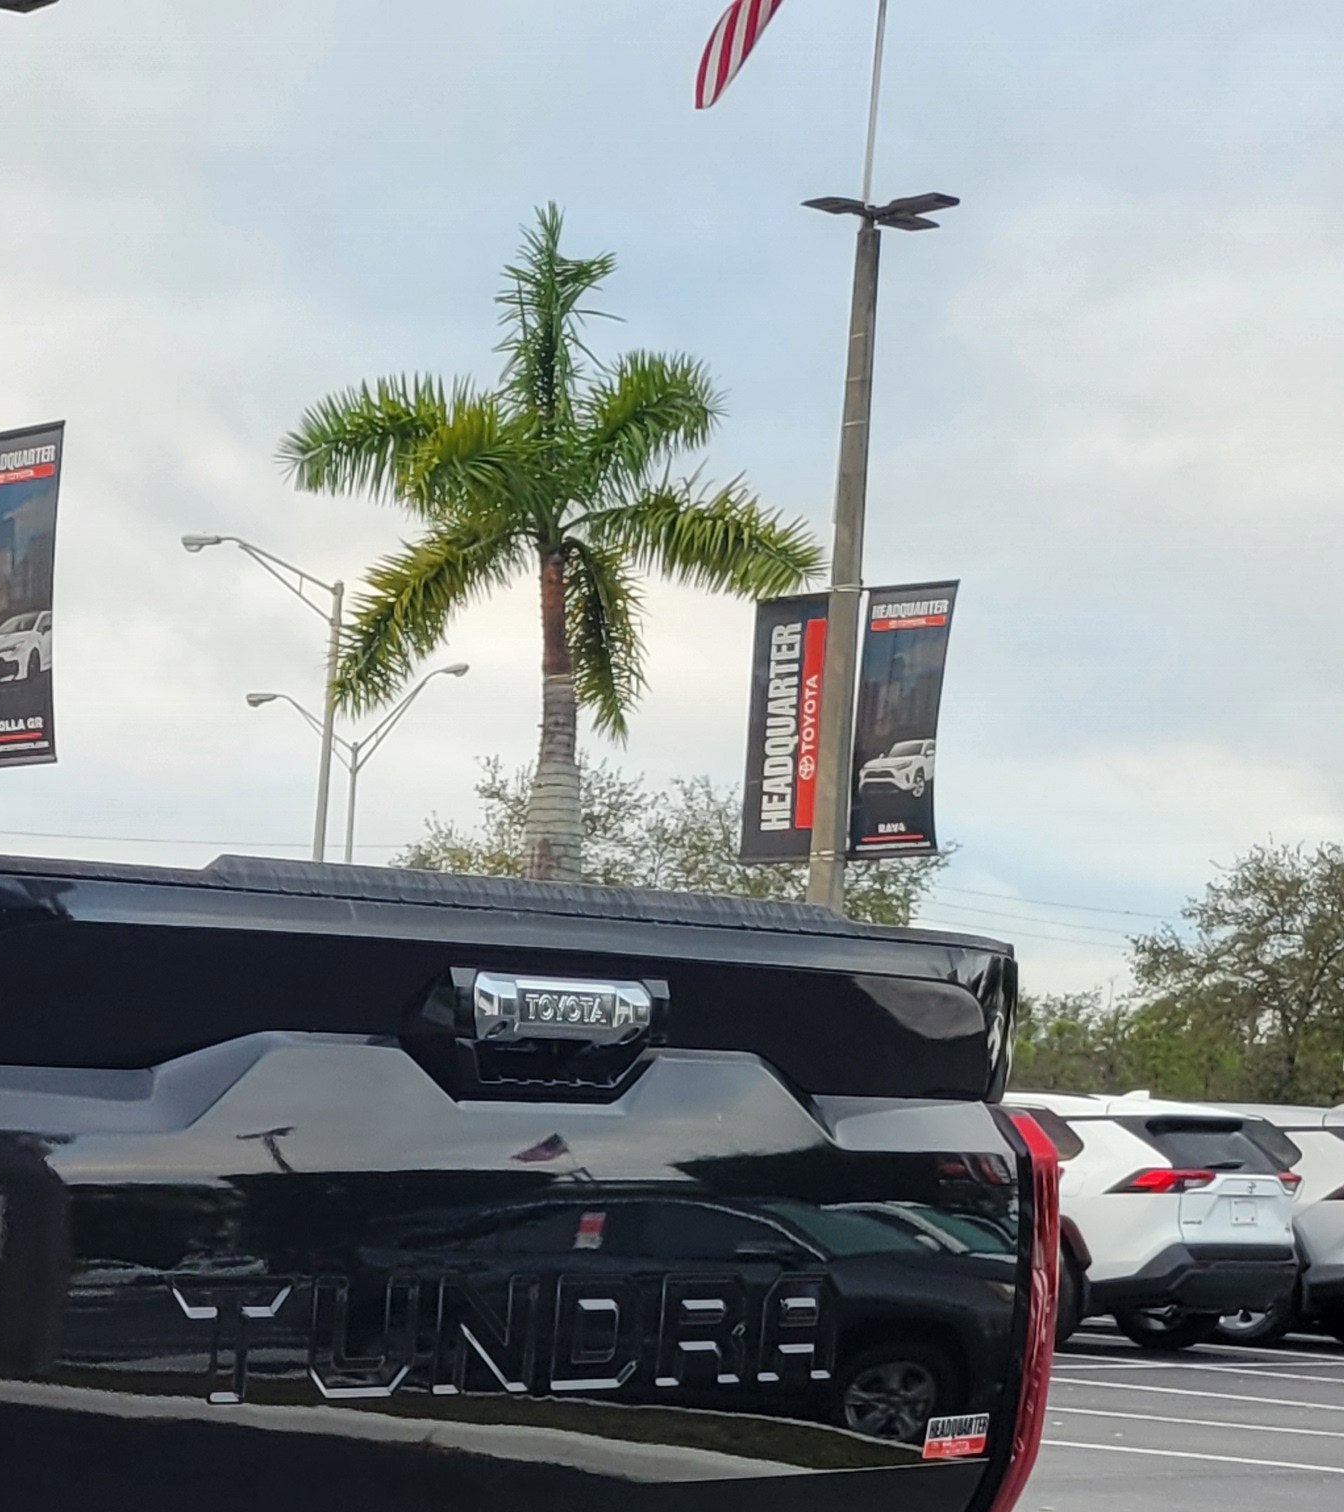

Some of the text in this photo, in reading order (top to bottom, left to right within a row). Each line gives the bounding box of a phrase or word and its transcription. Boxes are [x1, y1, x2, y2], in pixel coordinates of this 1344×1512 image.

[26, 716, 44, 729] GR
[760, 622, 802, 831] HEADQUARTER
[800, 674, 819, 754] TOYOTA
[525, 993, 607, 1024] TOYOTA
[170, 1274, 838, 1405] TUNDRA
[928, 1415, 990, 1439] HEADQUARTER
